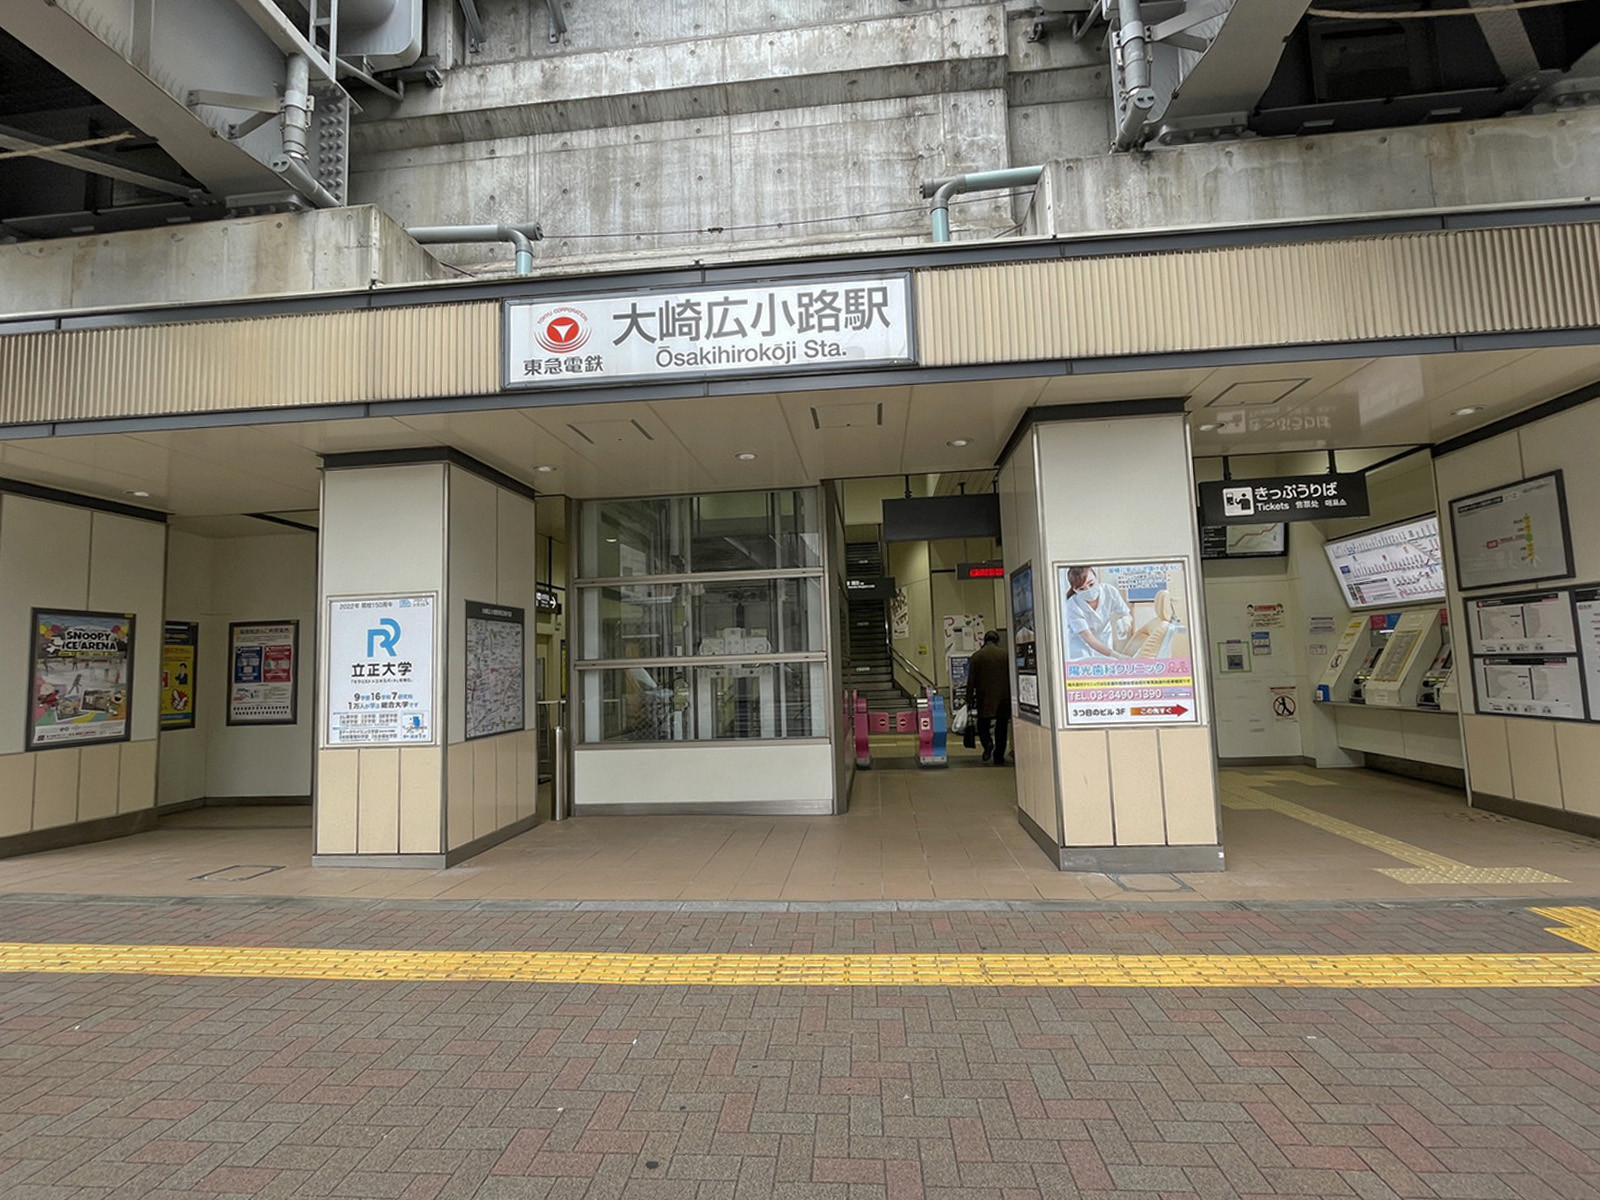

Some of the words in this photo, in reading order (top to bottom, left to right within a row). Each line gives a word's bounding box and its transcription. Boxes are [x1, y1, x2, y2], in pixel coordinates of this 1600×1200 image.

[612, 286, 890, 346] 大崎広小路駅
[656, 341, 797, 368] Ōsakihirokōji
[804, 340, 847, 358] Sta.
[523, 355, 604, 376] 東急電鉄
[1255, 482, 1338, 500] きっぷうりば
[1256, 502, 1290, 511] Tickets
[66, 631, 111, 641] SNOOPY
[62, 641, 79, 650] ICE
[80, 641, 117, 650] ARENA
[351, 661, 413, 677] 立正大学
[1068, 663, 1165, 676] 陽光歯科クリニック
